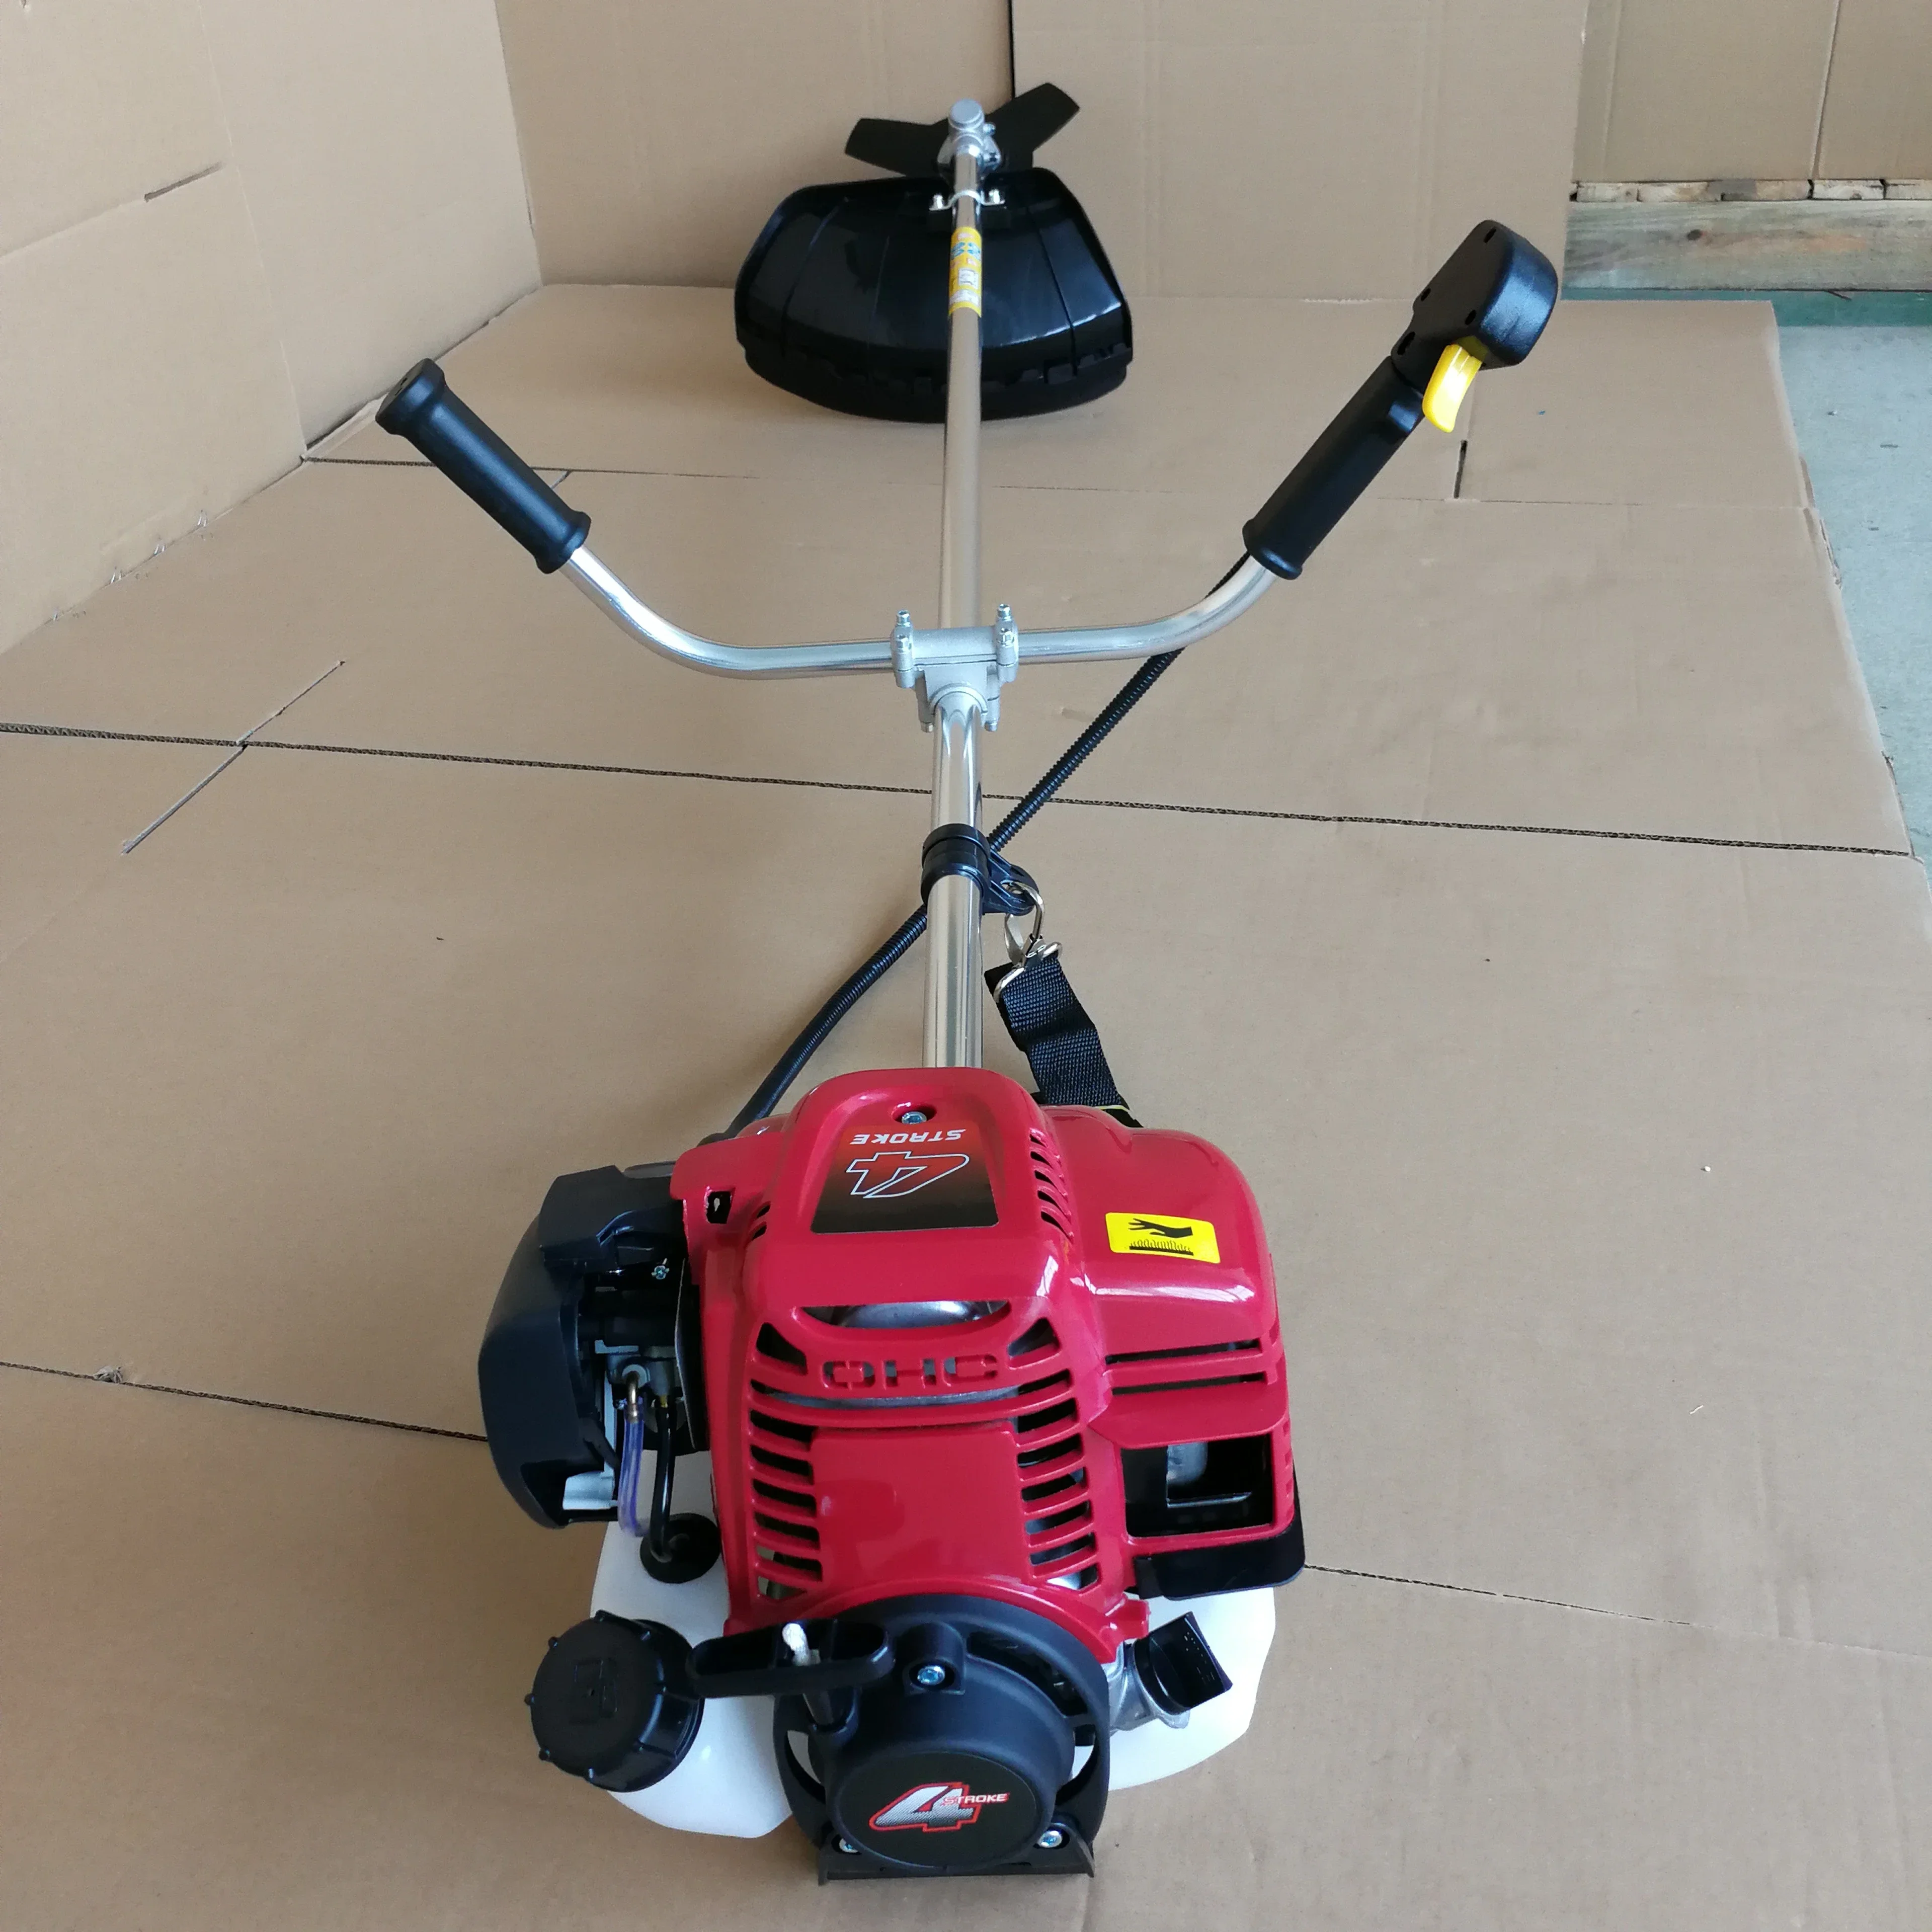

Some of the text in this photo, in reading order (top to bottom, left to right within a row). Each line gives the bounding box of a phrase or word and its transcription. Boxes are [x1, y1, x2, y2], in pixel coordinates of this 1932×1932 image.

[850, 1129, 967, 1145] STROKE
[846, 1151, 970, 1198] 4
[822, 1354, 998, 1390] OHC
[869, 1782, 1008, 1832] 4 STROKE
